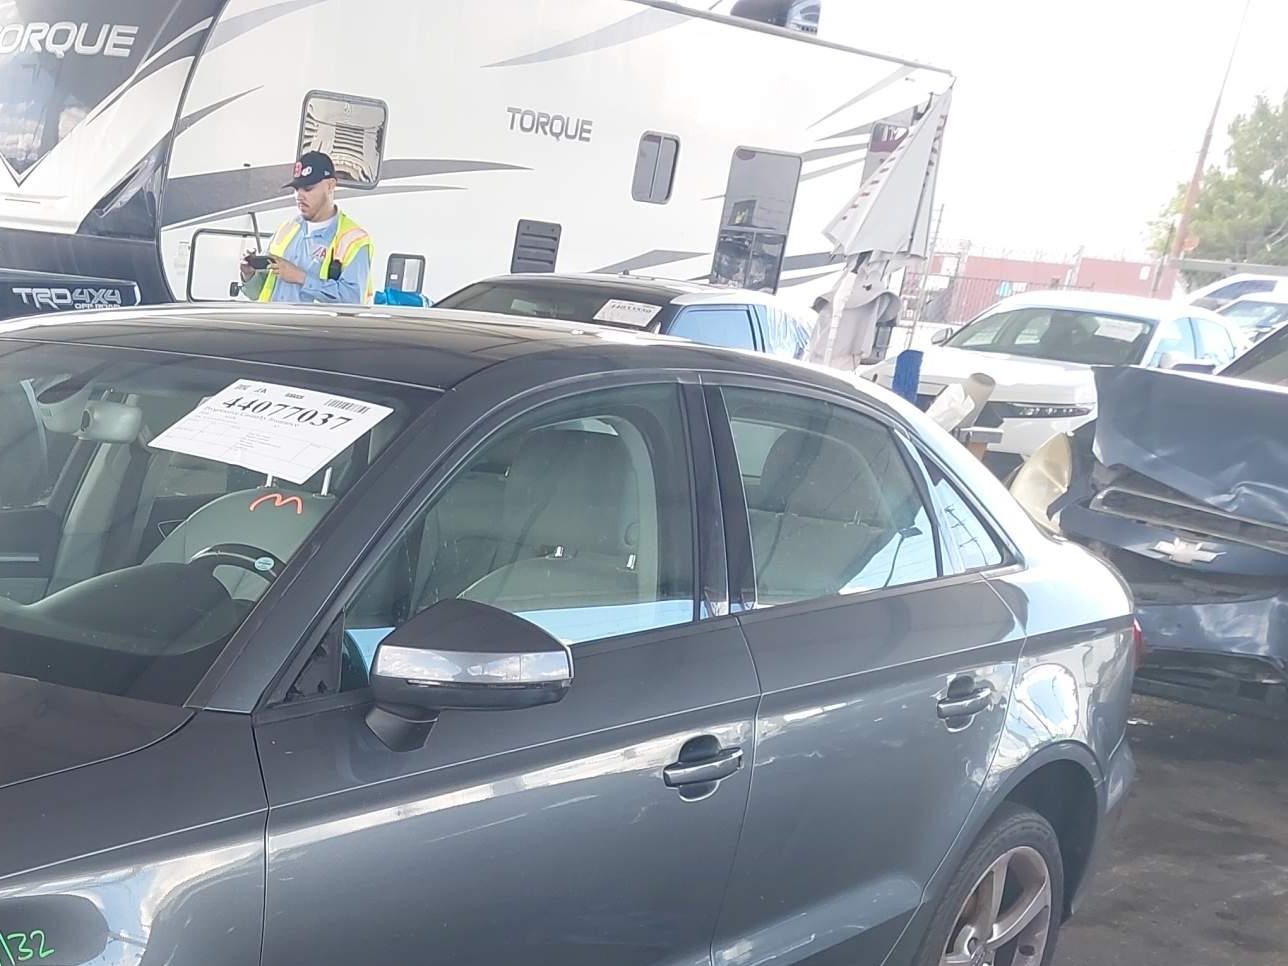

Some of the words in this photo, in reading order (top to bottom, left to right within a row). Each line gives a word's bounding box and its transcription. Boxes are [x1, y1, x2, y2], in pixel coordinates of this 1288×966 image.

[507, 106, 593, 142] TORQUE
[12, 287, 72, 310] TRD
[222, 397, 352, 430] 44077037
